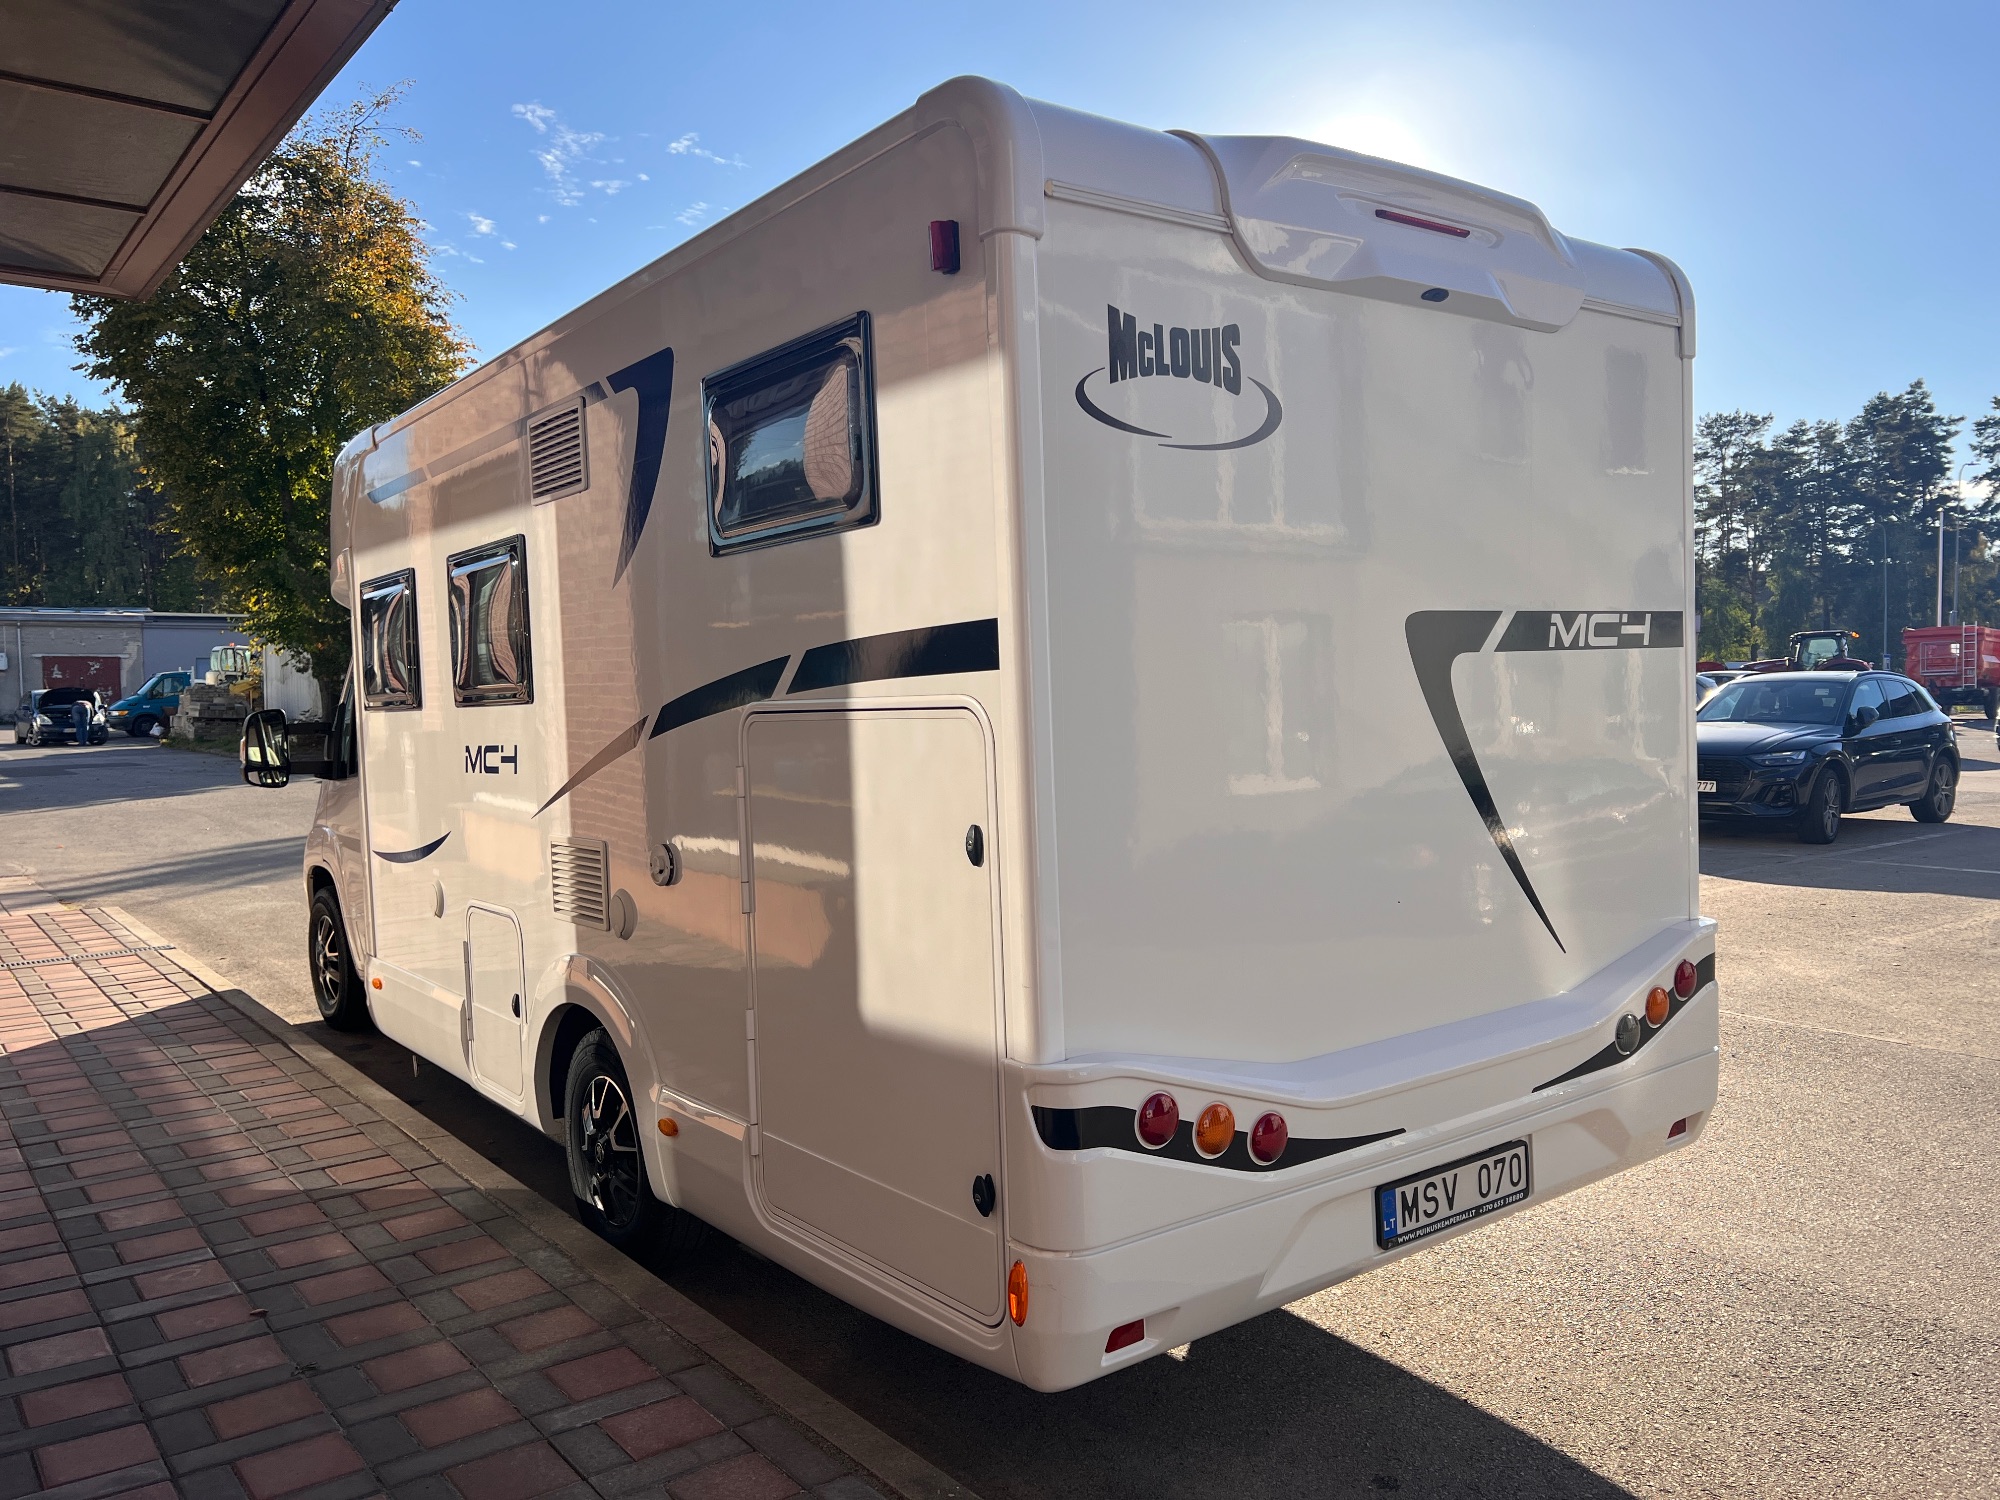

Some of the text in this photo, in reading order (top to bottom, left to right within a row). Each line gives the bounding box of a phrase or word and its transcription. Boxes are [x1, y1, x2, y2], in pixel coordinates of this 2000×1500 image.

[1697, 782, 1714, 790] 777
[1401, 1153, 1522, 1228] MSV 070
[1479, 1203, 1493, 1214] +370
[1494, 1199, 1504, 1209] 655
[1384, 1218, 1396, 1231] LT
